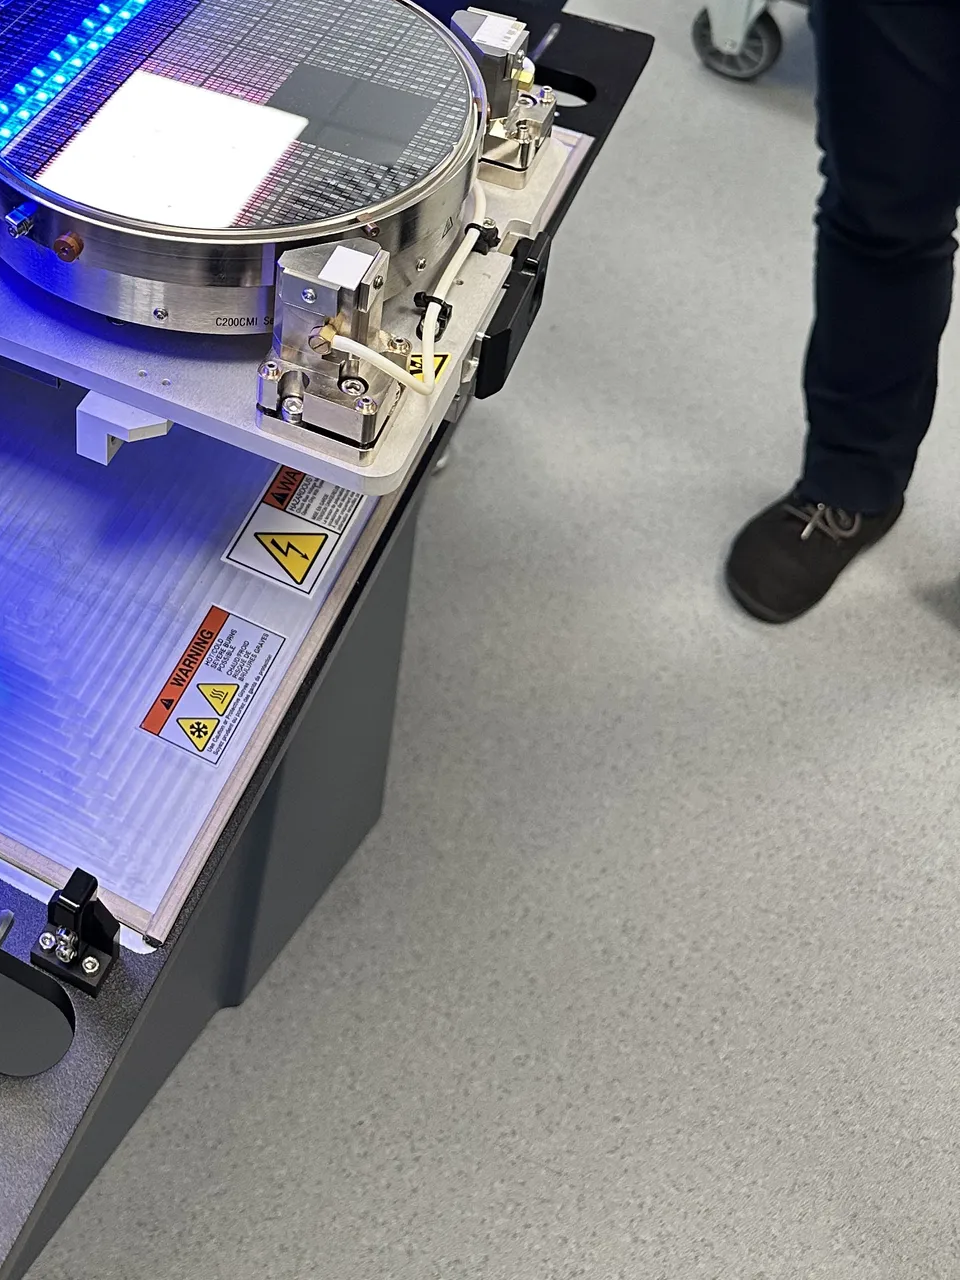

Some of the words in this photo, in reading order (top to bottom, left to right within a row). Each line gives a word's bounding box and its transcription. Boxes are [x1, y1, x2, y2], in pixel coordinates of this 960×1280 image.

[215, 316, 258, 327] C200CMI
[288, 477, 312, 511] HAZARDOUS
[204, 638, 223, 665] HOT/COLD
[210, 647, 226, 668] SEVERE
[222, 628, 237, 647] BURNS
[253, 632, 268, 653] GRAVES
[170, 628, 214, 688] WARNING
[216, 644, 236, 671] POSSIBLE
[232, 658, 247, 678] RISQUE
[243, 650, 251, 658] DE
[206, 742, 215, 752] Use
[212, 724, 225, 742] Caution
[225, 697, 240, 719] Protective
[237, 682, 249, 697] Gloves
[221, 723, 234, 741] prudent
